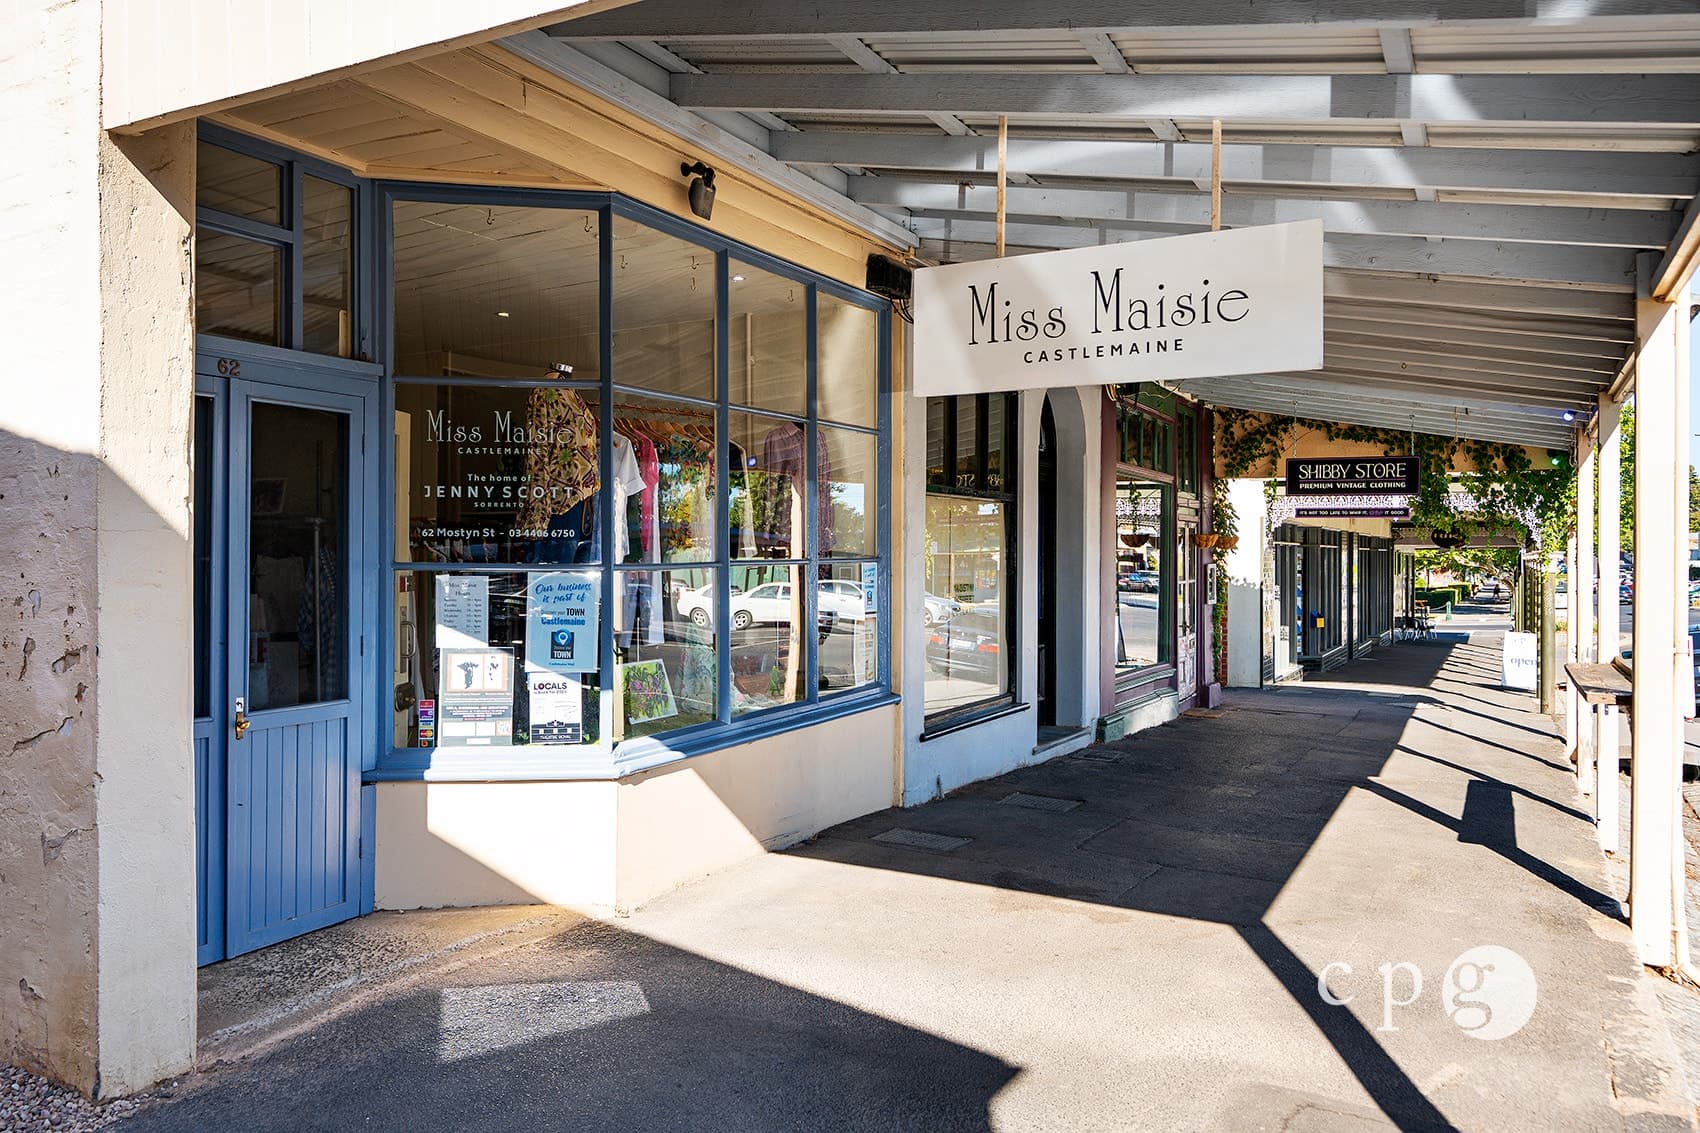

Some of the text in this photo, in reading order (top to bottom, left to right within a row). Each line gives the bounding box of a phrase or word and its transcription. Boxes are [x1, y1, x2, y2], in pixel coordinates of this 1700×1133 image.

[967, 267, 1251, 346] Miss Maisie
[1023, 338, 1185, 365] CASTLEMAINE
[217, 358, 241, 377] 62
[426, 409, 574, 444] Miss Maisie
[457, 447, 542, 455] CASTLEMAINE
[1298, 462, 1407, 480] SHIBBY STORE
[467, 473, 532, 482] The home of
[424, 485, 574, 498] JENNY SCOTT
[421, 528, 435, 538] 62
[436, 528, 480, 540] Mostyn
[482, 528, 496, 538] St
[509, 528, 523, 538] 03
[523, 529, 549, 538] 4406
[551, 529, 576, 538] 6750
[535, 583, 592, 595] Our business
[542, 592, 586, 603] is part of
[566, 607, 585, 616] TOWN
[553, 650, 572, 658] TOWN
[1510, 657, 1537, 668] open
[533, 682, 567, 690] LOCALS
